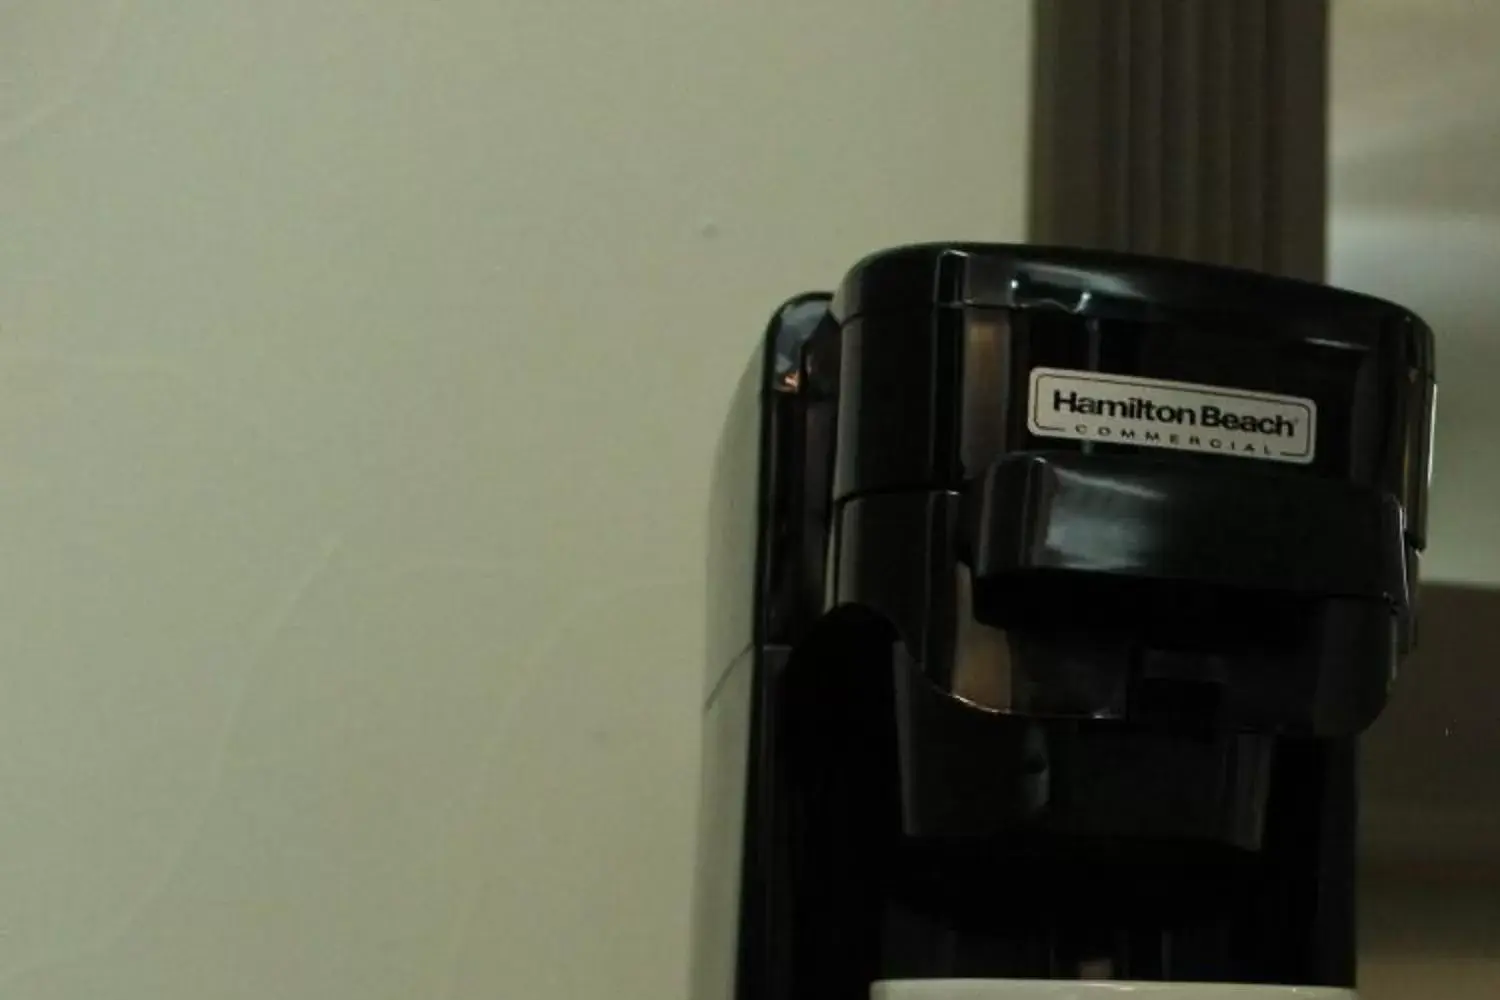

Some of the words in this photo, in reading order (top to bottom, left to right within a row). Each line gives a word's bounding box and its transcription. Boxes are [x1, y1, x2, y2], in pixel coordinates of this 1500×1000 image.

[1053, 389, 1196, 426] Hamilton
[1200, 404, 1296, 438] Beach
[1074, 423, 1272, 456] COMMERCIAL
